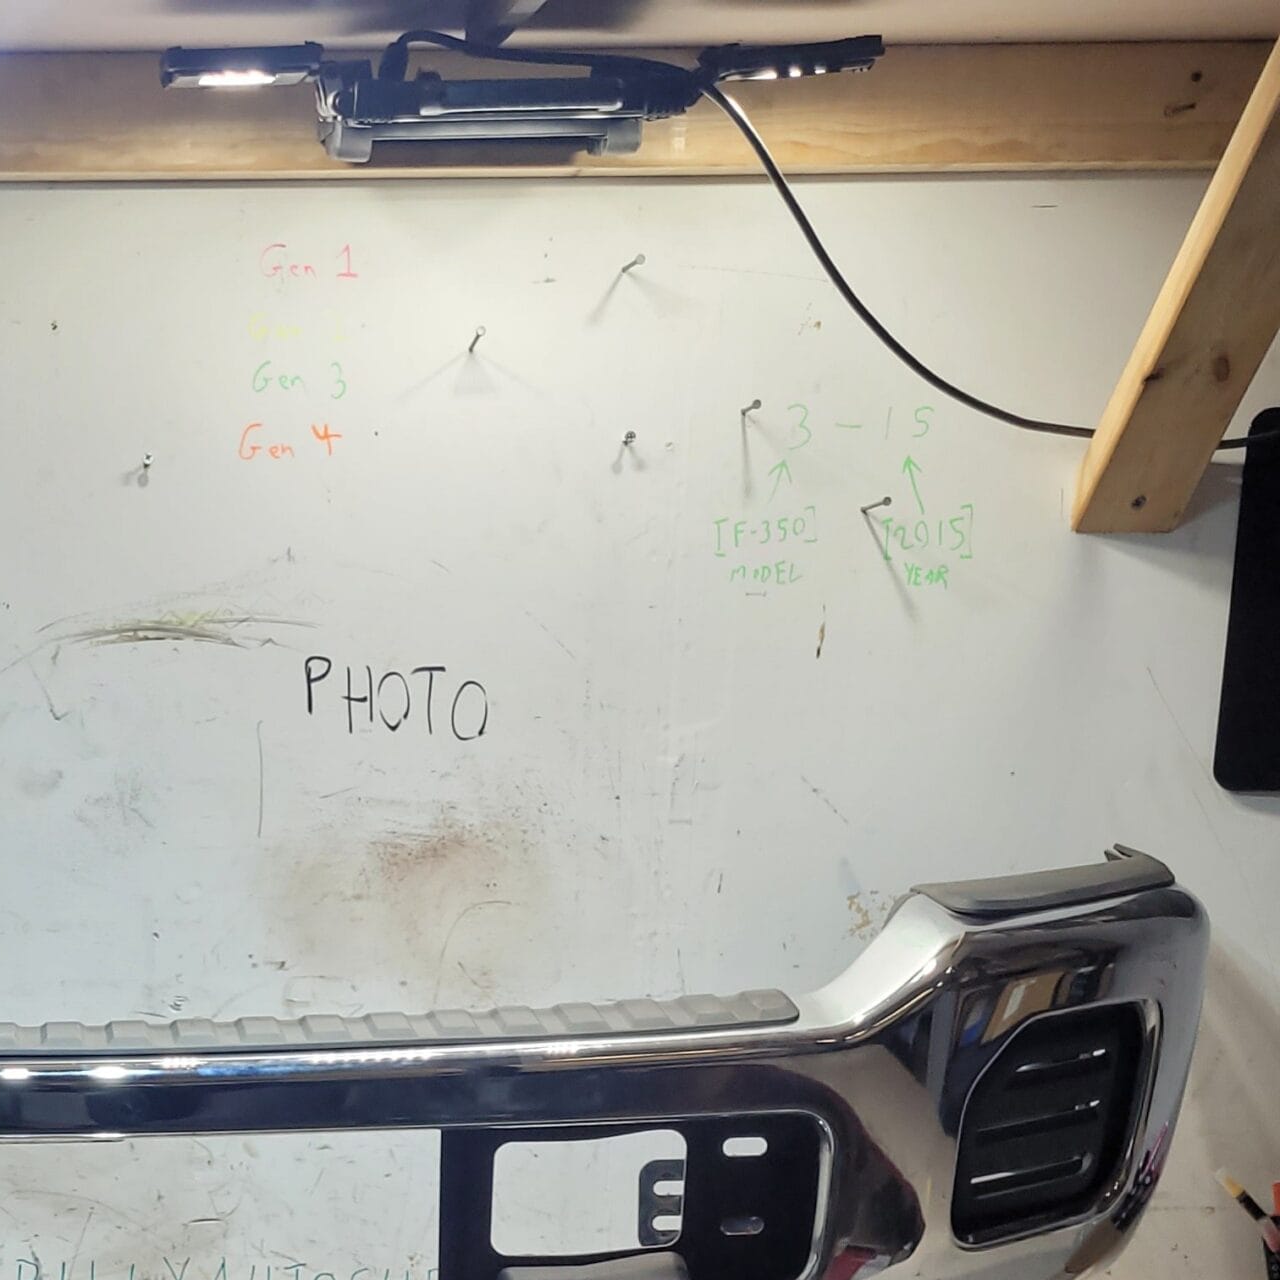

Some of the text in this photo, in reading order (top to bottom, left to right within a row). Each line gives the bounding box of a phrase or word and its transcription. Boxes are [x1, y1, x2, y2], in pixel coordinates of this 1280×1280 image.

[260, 244, 359, 278] Gen 1
[251, 360, 347, 400] Gen 3
[238, 422, 343, 461] Gen 4
[904, 562, 950, 590] YEAR
[304, 655, 489, 741] PHOTO
